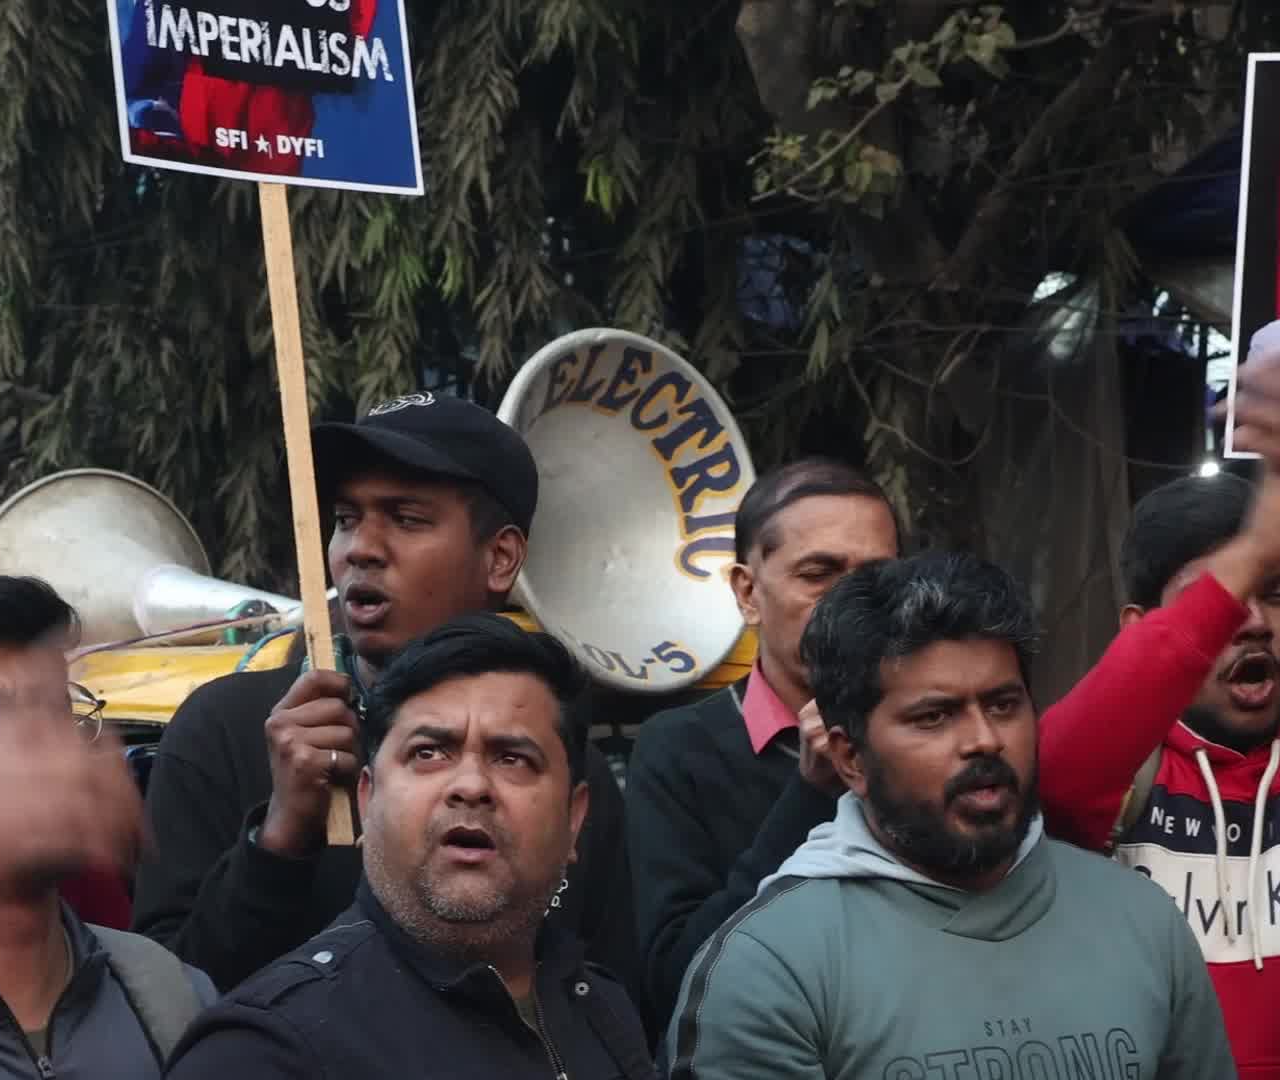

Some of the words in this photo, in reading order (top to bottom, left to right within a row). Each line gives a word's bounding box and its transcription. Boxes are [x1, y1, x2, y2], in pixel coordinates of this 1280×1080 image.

[144, 0, 395, 83] IMPERIALISM
[215, 127, 248, 151] SFI
[276, 134, 325, 159] DYFI
[540, 342, 742, 578] ELECTRIC
[1150, 806, 1201, 838] NEW
[983, 1017, 1033, 1038] STAY
